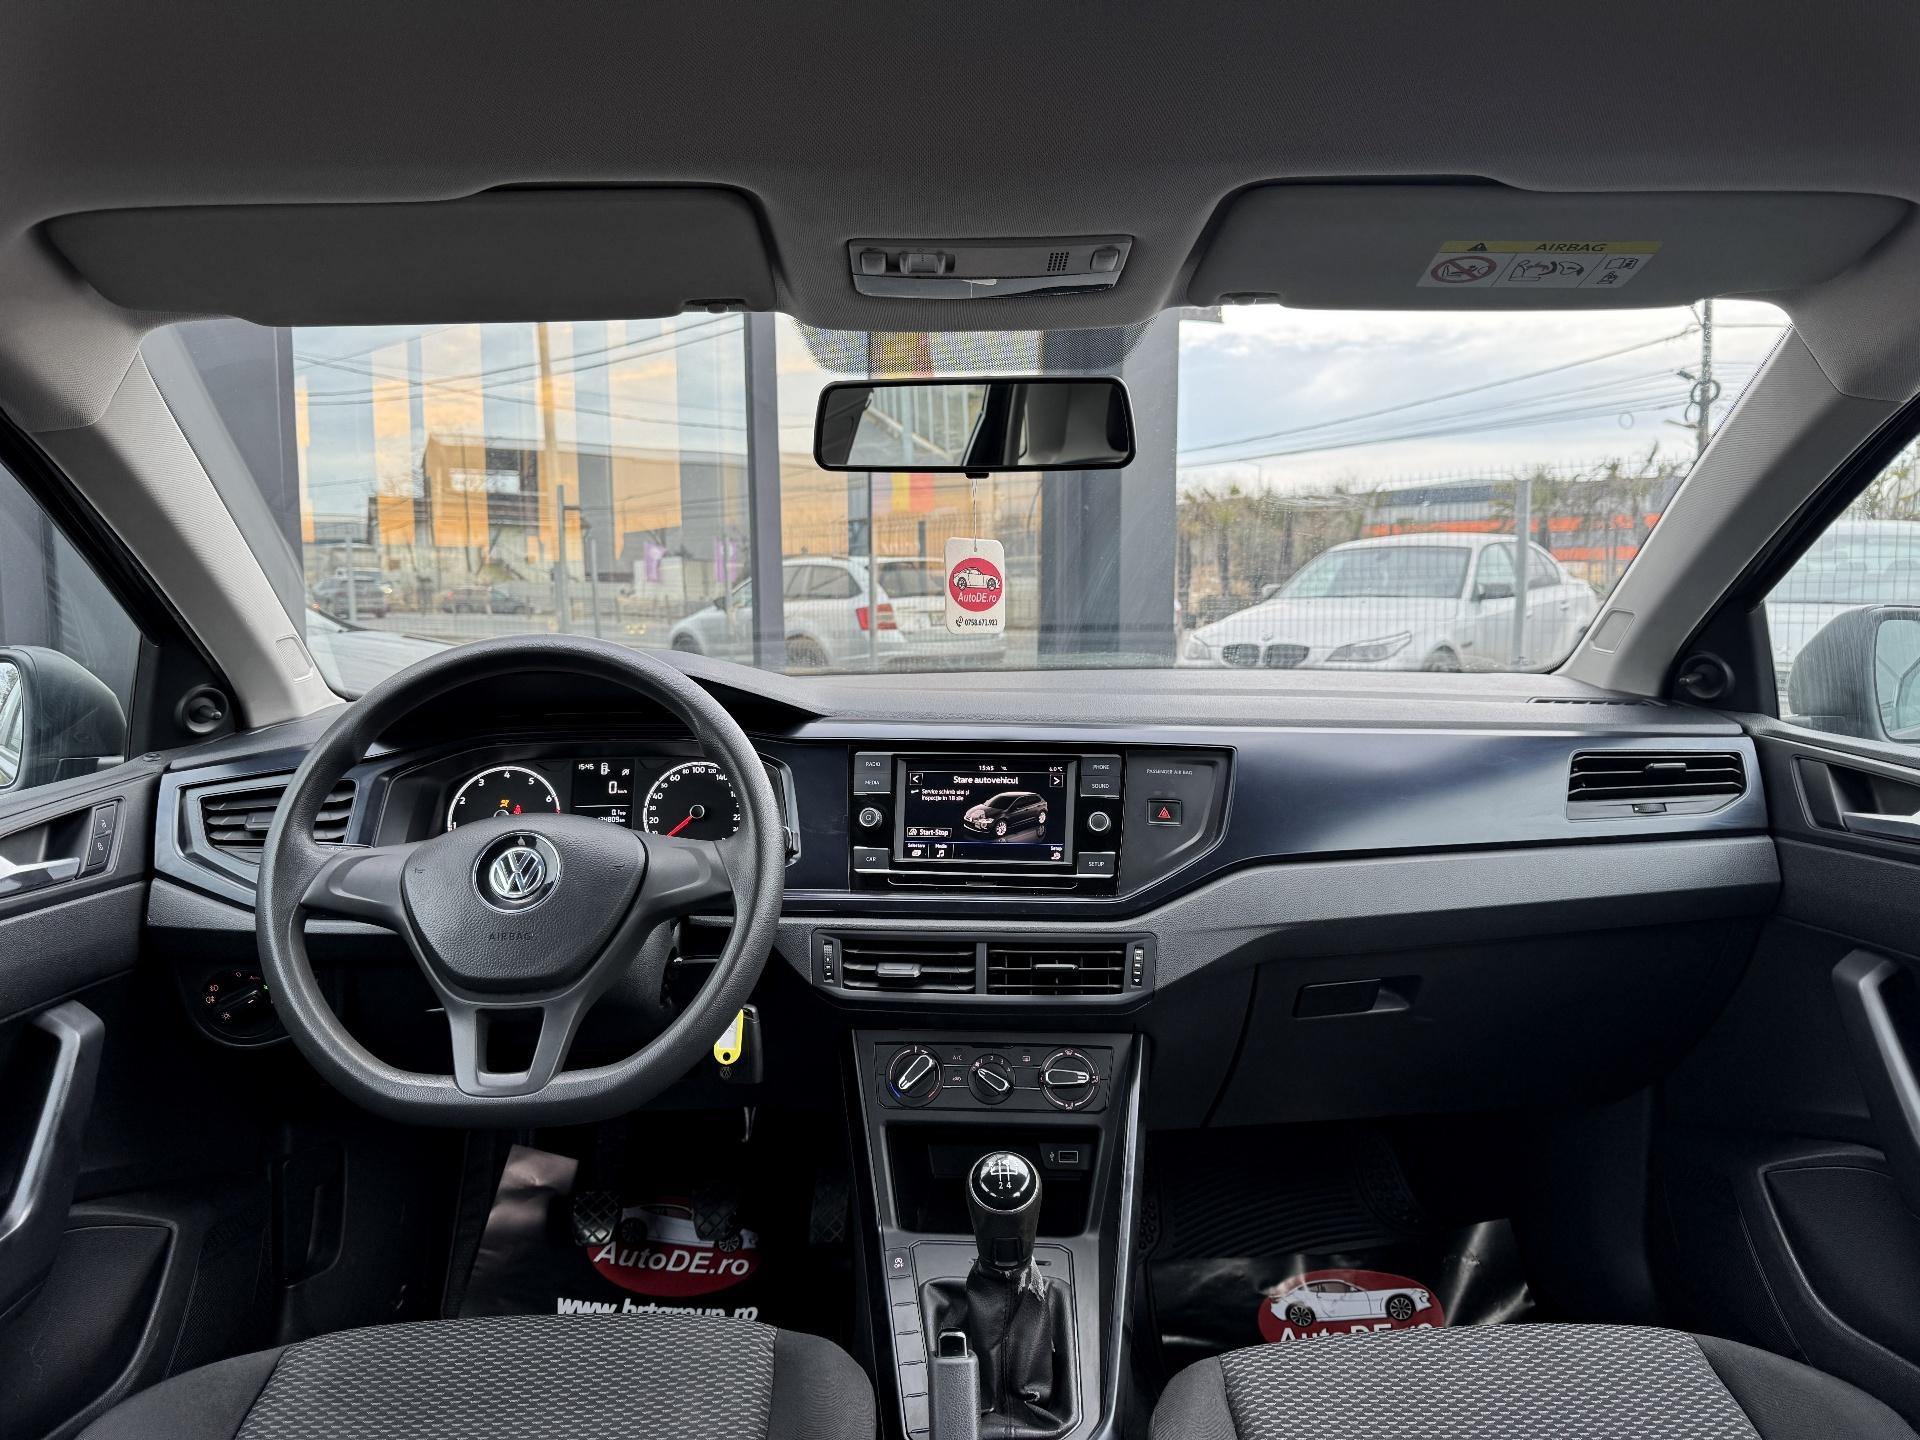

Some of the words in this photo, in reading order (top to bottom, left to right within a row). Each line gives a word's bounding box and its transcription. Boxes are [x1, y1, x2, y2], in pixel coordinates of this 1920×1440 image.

[1536, 243, 1608, 252] AIRBAG
[957, 592, 997, 603] AutoDE.ro
[692, 766, 706, 774] 100
[504, 771, 510, 779] 4
[669, 774, 681, 782] 60
[478, 778, 485, 787] 3
[528, 777, 534, 785] 5
[953, 775, 974, 784] Stare
[974, 775, 1019, 785] autovehicul
[608, 780, 618, 794] 0
[459, 796, 466, 805] 2
[545, 794, 553, 803] 6
[652, 792, 663, 800] 40
[648, 816, 659, 824] 20
[919, 829, 949, 837] Start-Stop
[489, 932, 532, 941] AIRBAG
[998, 1182, 1003, 1190] 2
[593, 1241, 749, 1275] AutoDE.ro
